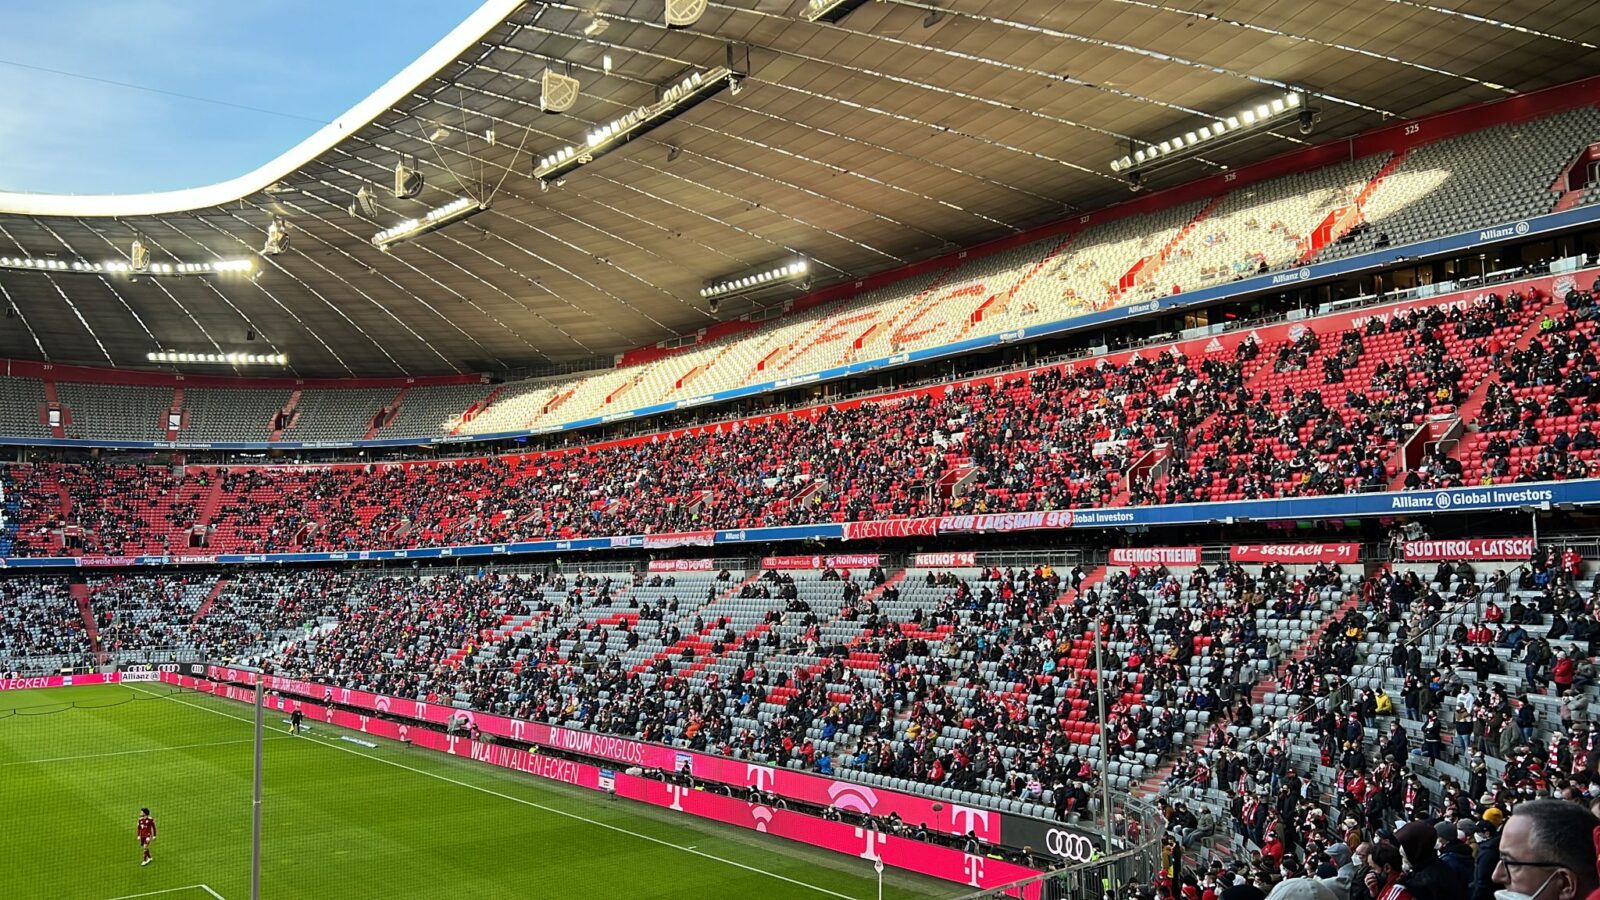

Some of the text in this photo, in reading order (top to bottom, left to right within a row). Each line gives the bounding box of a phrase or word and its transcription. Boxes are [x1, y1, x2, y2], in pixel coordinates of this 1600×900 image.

[1405, 123, 1420, 136] 325
[1225, 172, 1236, 182] 326
[1480, 226, 1514, 241] Allianz
[1272, 271, 1299, 284] Allianz
[1128, 303, 1150, 315] Allianz
[1352, 293, 1492, 329] wwwfcern.de
[1392, 489, 1552, 508] Allianz Global Investors
[939, 511, 1073, 530] CLUB LAUSHAM 98
[1096, 512, 1134, 522] Investors
[1113, 548, 1197, 563] KLEINOSTHEIM
[1237, 545, 1249, 555] 19
[1260, 545, 1323, 556] SESSLACH
[1337, 545, 1351, 556] 91
[1405, 540, 1474, 557] SÜDTIROL
[1482, 539, 1533, 556] LATSCH
[916, 554, 955, 565] NEUHOF
[9, 677, 49, 690] ECKEN
[415, 701, 426, 720] T
[510, 718, 524, 741] T
[549, 727, 593, 753] RUNDUM
[499, 746, 509, 768] IN
[509, 751, 542, 775] ALLEN
[543, 757, 580, 784] ECKEN
[746, 763, 775, 794] T
[952, 805, 988, 841] T
[964, 853, 984, 888] T
